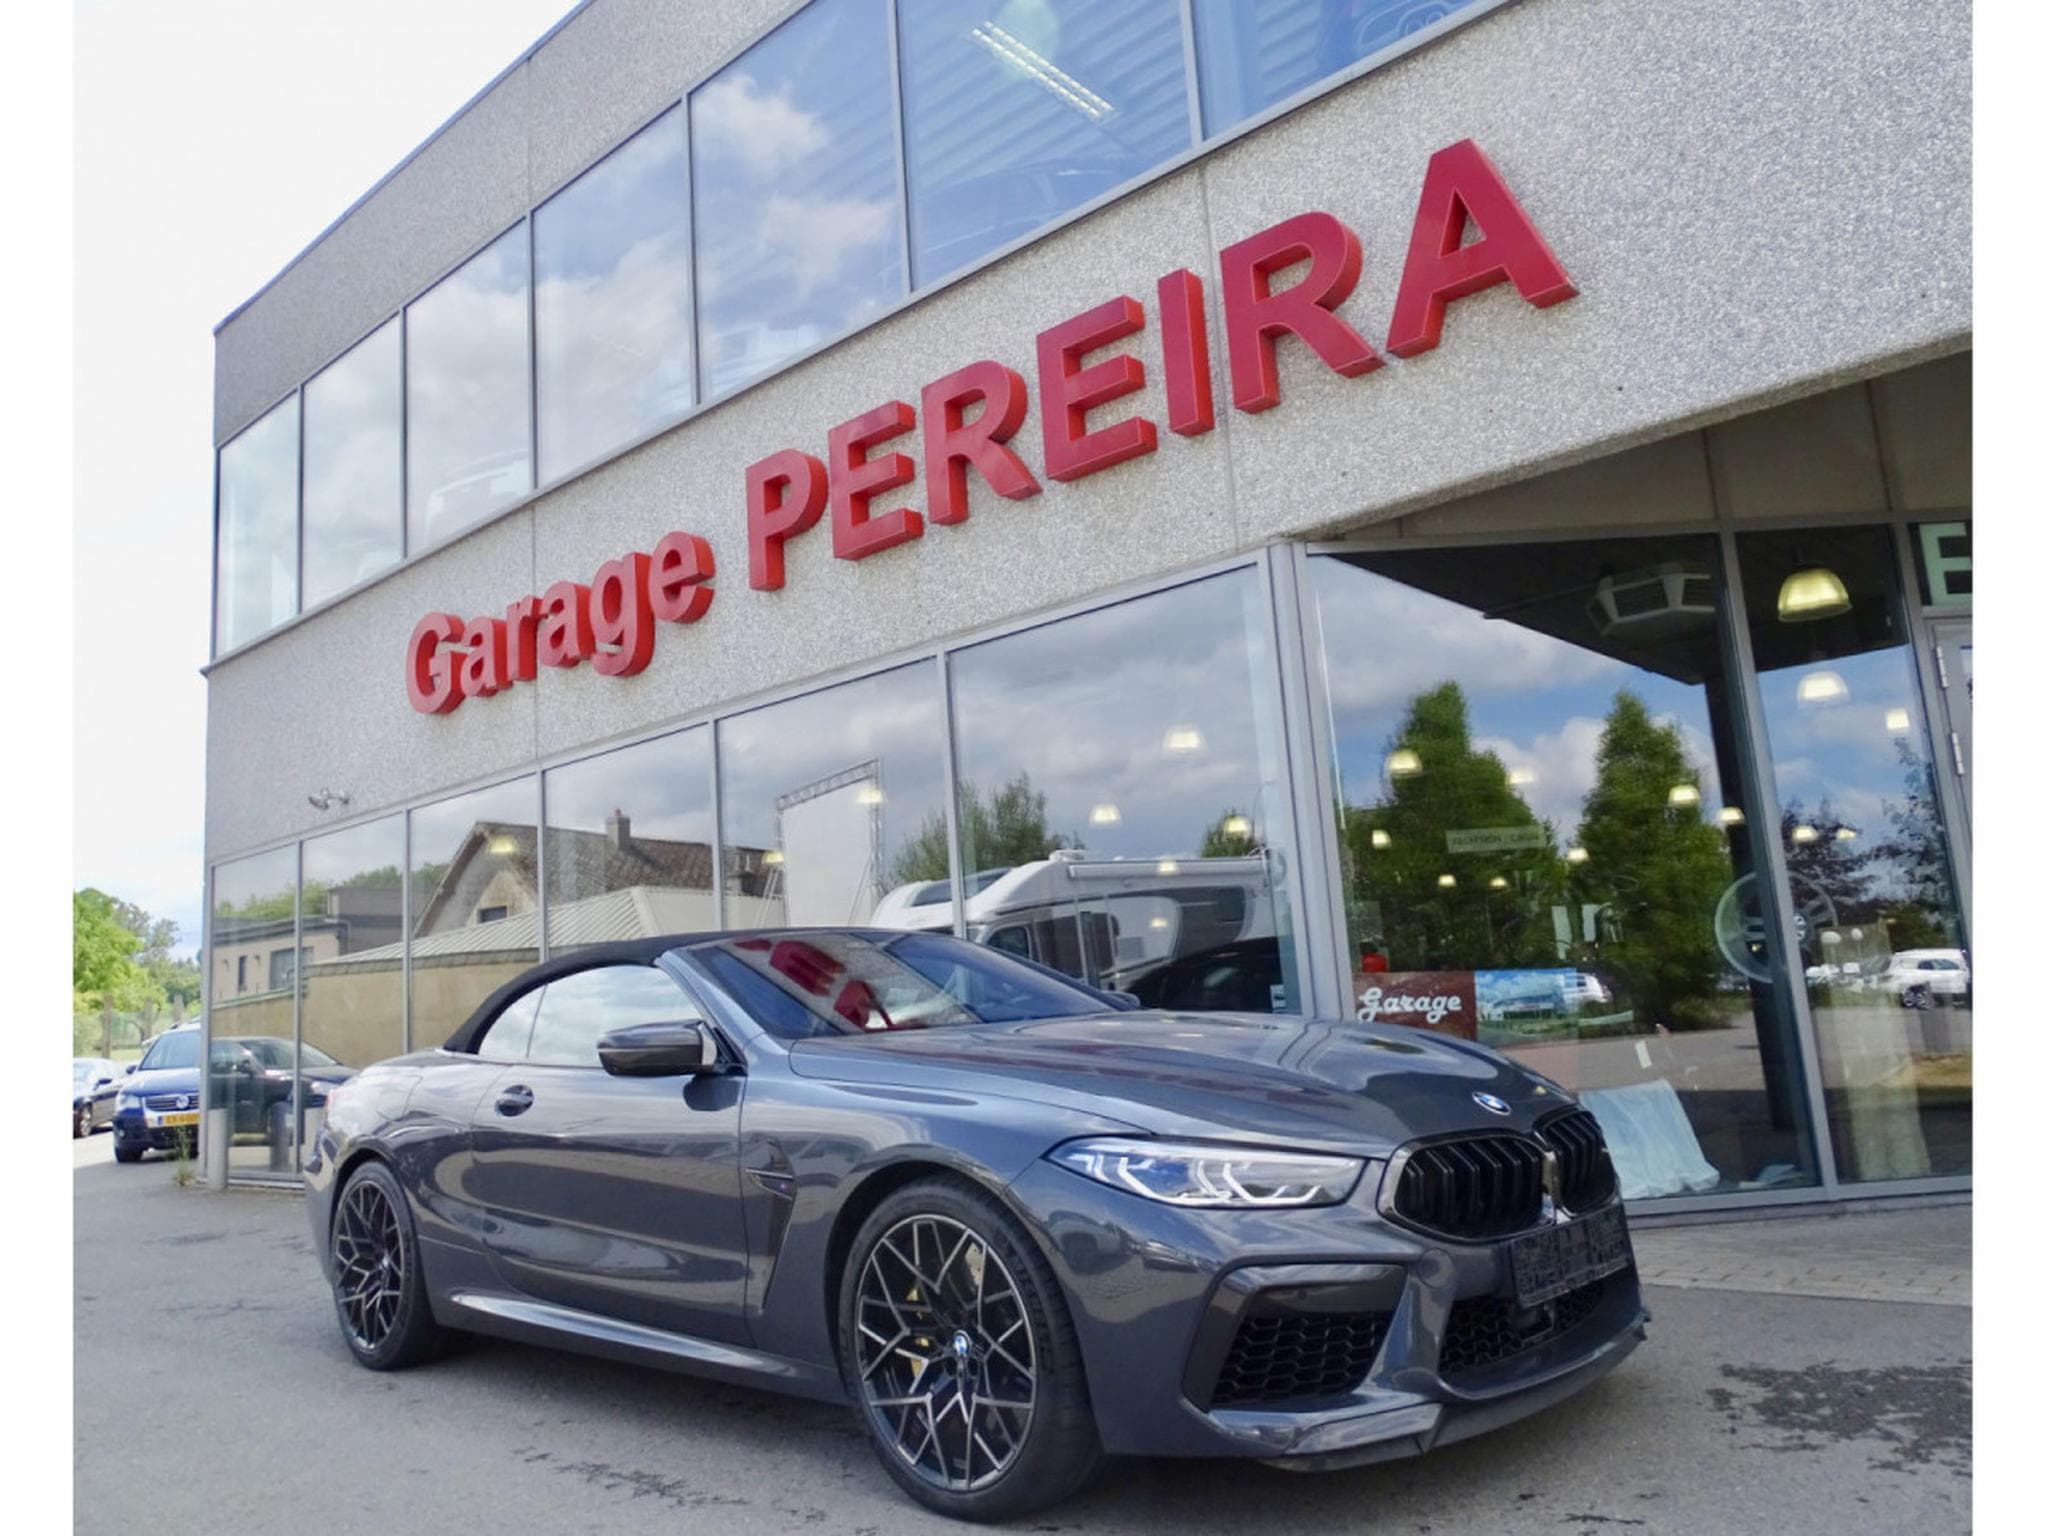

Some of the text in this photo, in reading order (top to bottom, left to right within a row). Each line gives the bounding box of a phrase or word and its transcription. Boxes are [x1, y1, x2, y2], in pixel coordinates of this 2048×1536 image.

[406, 138, 1579, 715] Garage PEREIRA
[1357, 987, 1462, 1024] Garage
